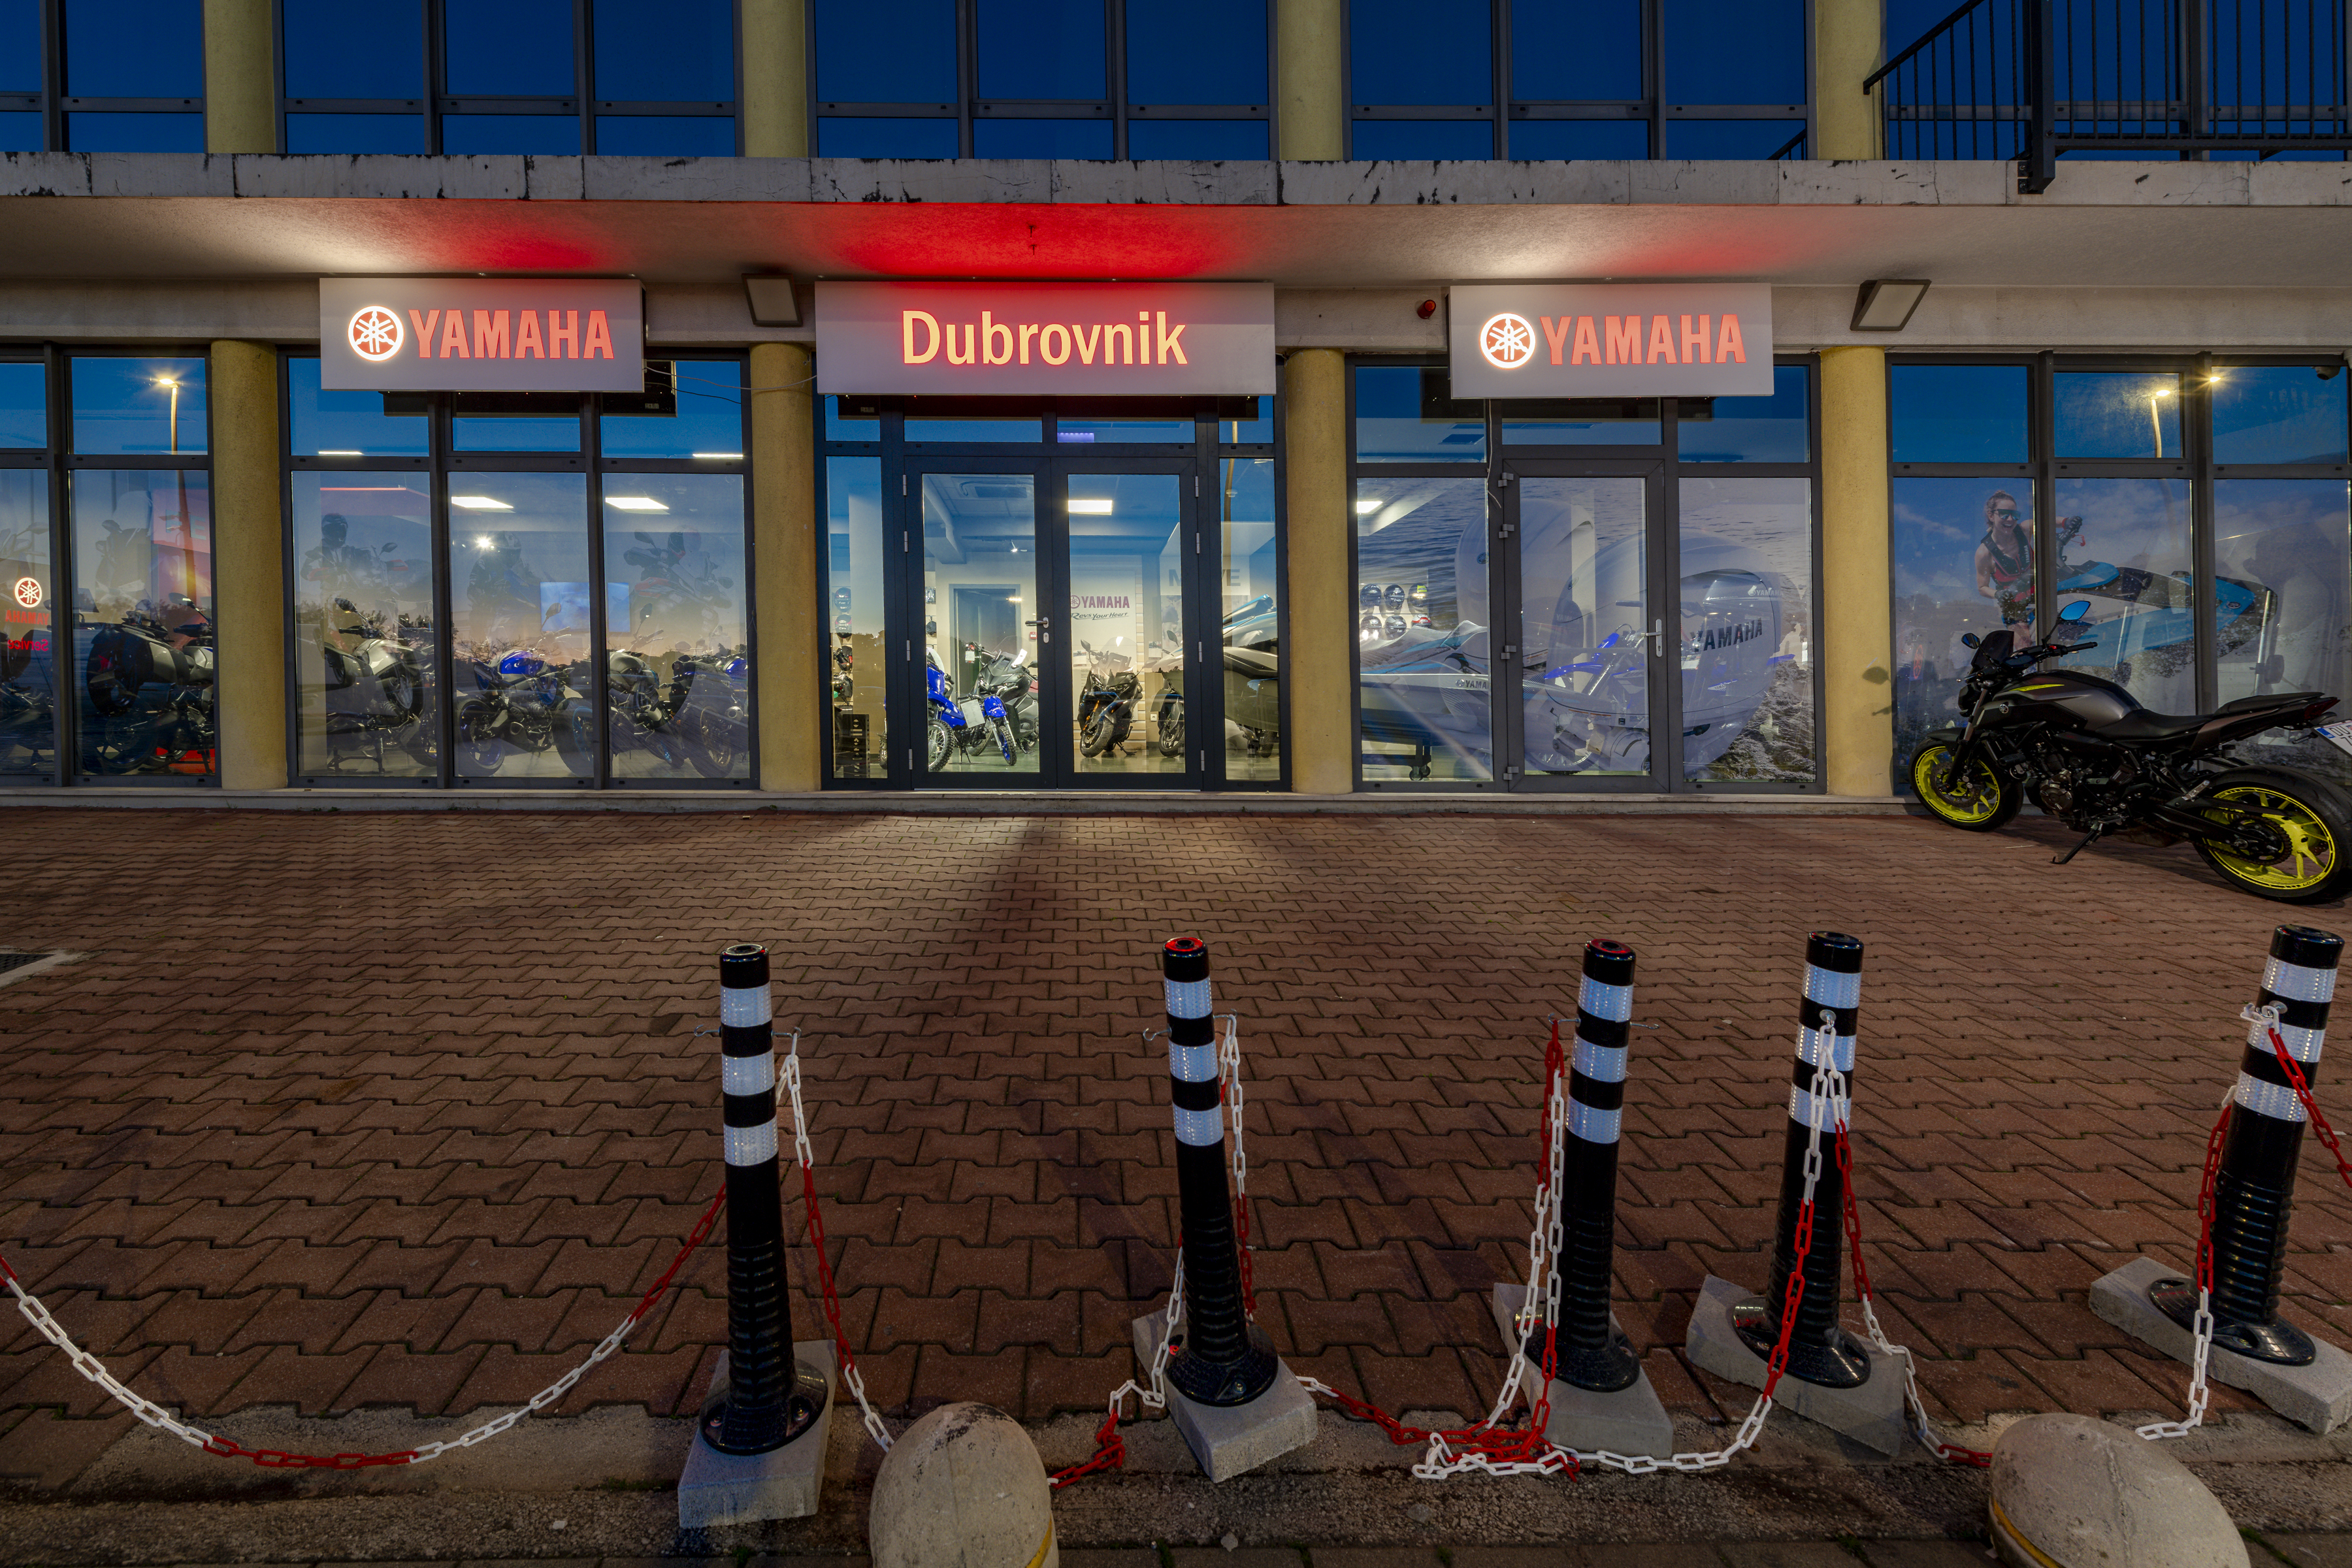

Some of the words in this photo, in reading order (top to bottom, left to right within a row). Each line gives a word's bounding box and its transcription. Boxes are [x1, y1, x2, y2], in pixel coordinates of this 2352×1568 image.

[408, 309, 615, 359] YAMAHA
[902, 310, 1188, 365] Dubrovnik
[1539, 314, 1746, 365] YAMAHA
[1081, 596, 1130, 608] YAMAHA
[1690, 617, 1763, 652] YAMAHA
[1465, 680, 1489, 689] YAMA
[2329, 725, 2351, 736] DU
